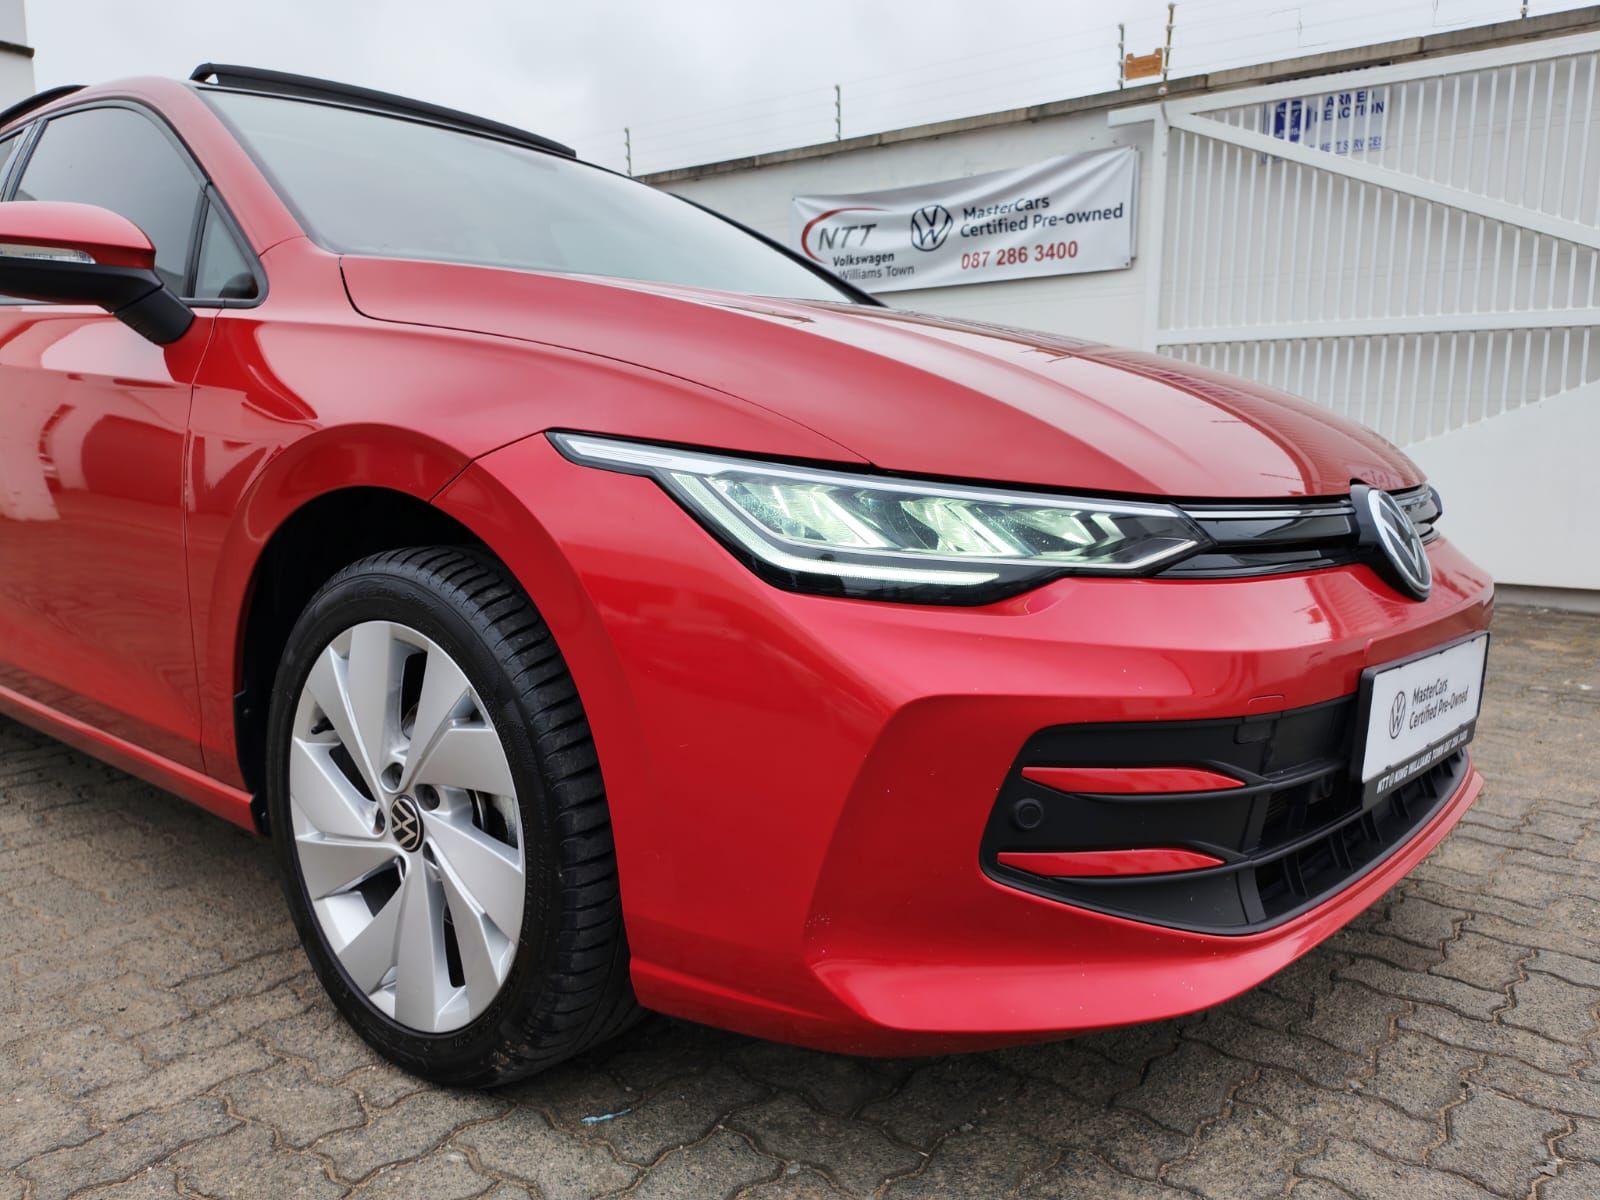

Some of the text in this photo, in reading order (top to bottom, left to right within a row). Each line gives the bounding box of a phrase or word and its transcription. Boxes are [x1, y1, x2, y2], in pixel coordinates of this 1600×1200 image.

[1326, 91, 1375, 107] ARME
[960, 203, 1124, 238] Certified Pre-owned
[963, 196, 1050, 221] MasterCars
[818, 223, 877, 251] NTT
[832, 253, 895, 267] Volkswagen
[961, 240, 1078, 270] 087 286 3400
[886, 265, 915, 278] Town
[1412, 678, 1448, 707] MasterCars
[1409, 699, 1438, 730] Certified
